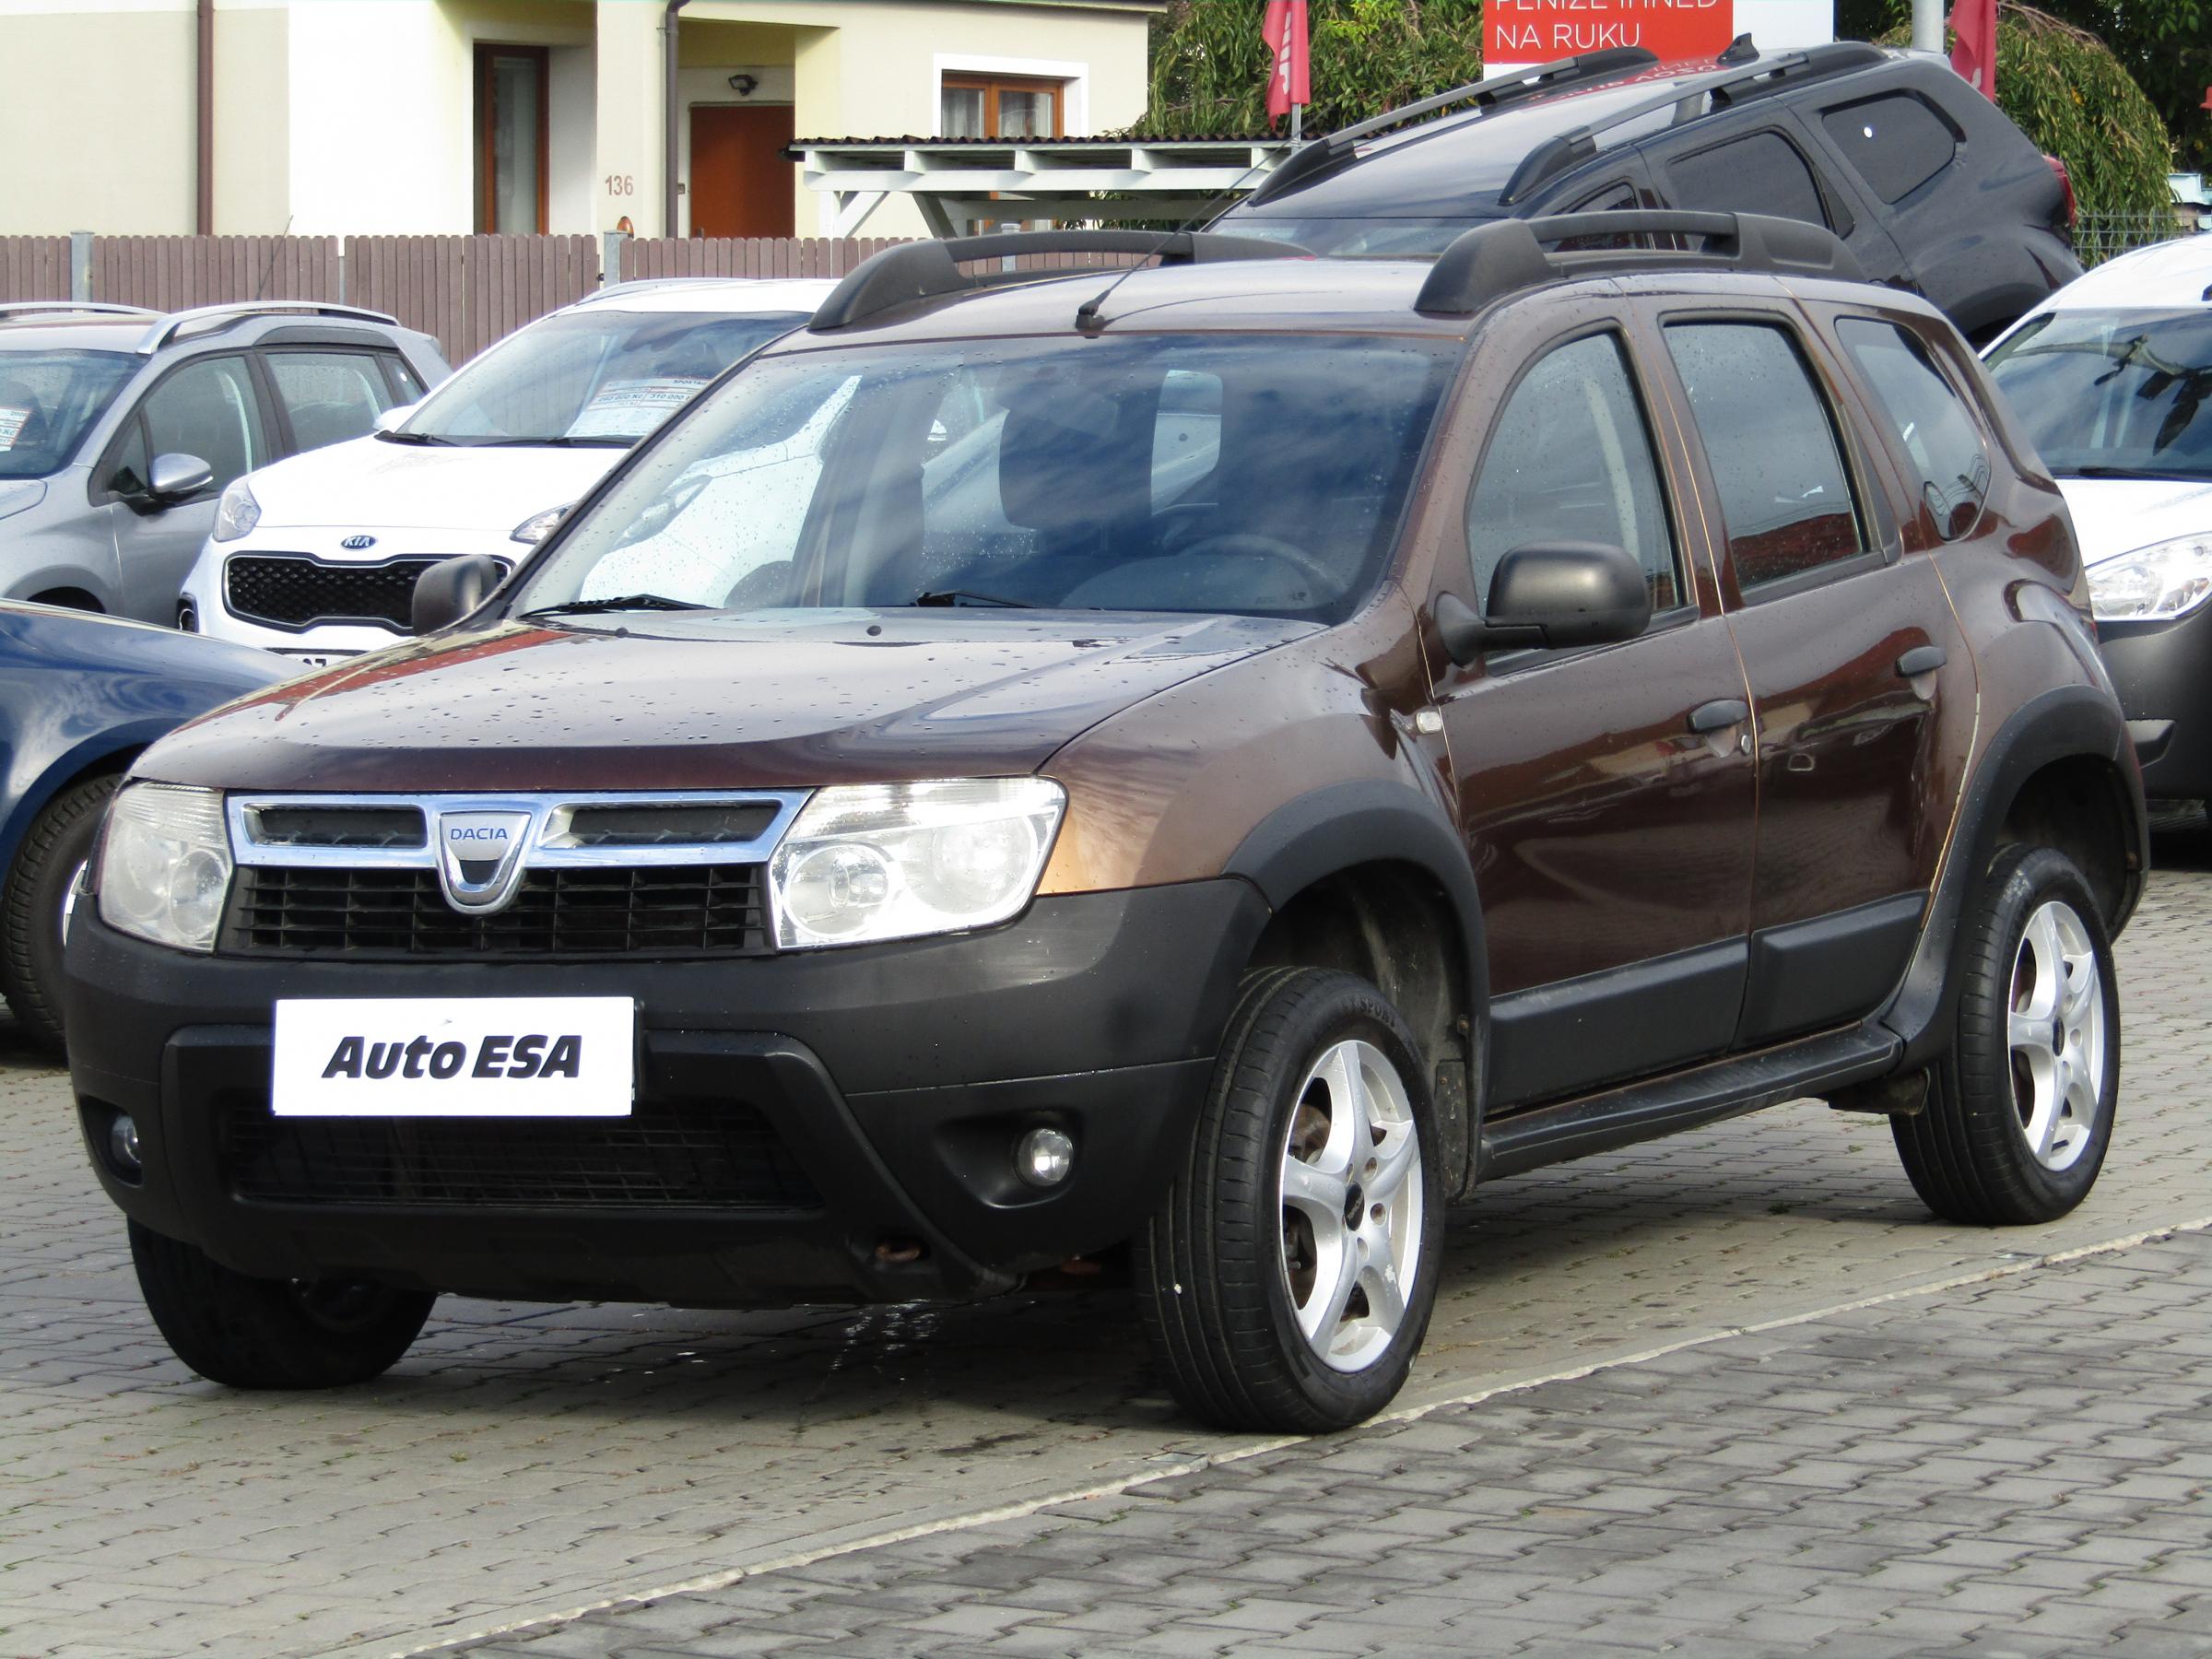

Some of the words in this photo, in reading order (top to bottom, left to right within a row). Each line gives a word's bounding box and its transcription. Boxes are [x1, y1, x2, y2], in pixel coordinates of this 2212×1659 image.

[1497, 24, 1542, 50] NA
[1553, 23, 1640, 49] RUKU
[605, 174, 634, 196] 136
[344, 536, 371, 547] KIA
[450, 828, 509, 840] DACIA
[322, 1035, 466, 1079] Auto
[471, 1034, 582, 1078] ESA
